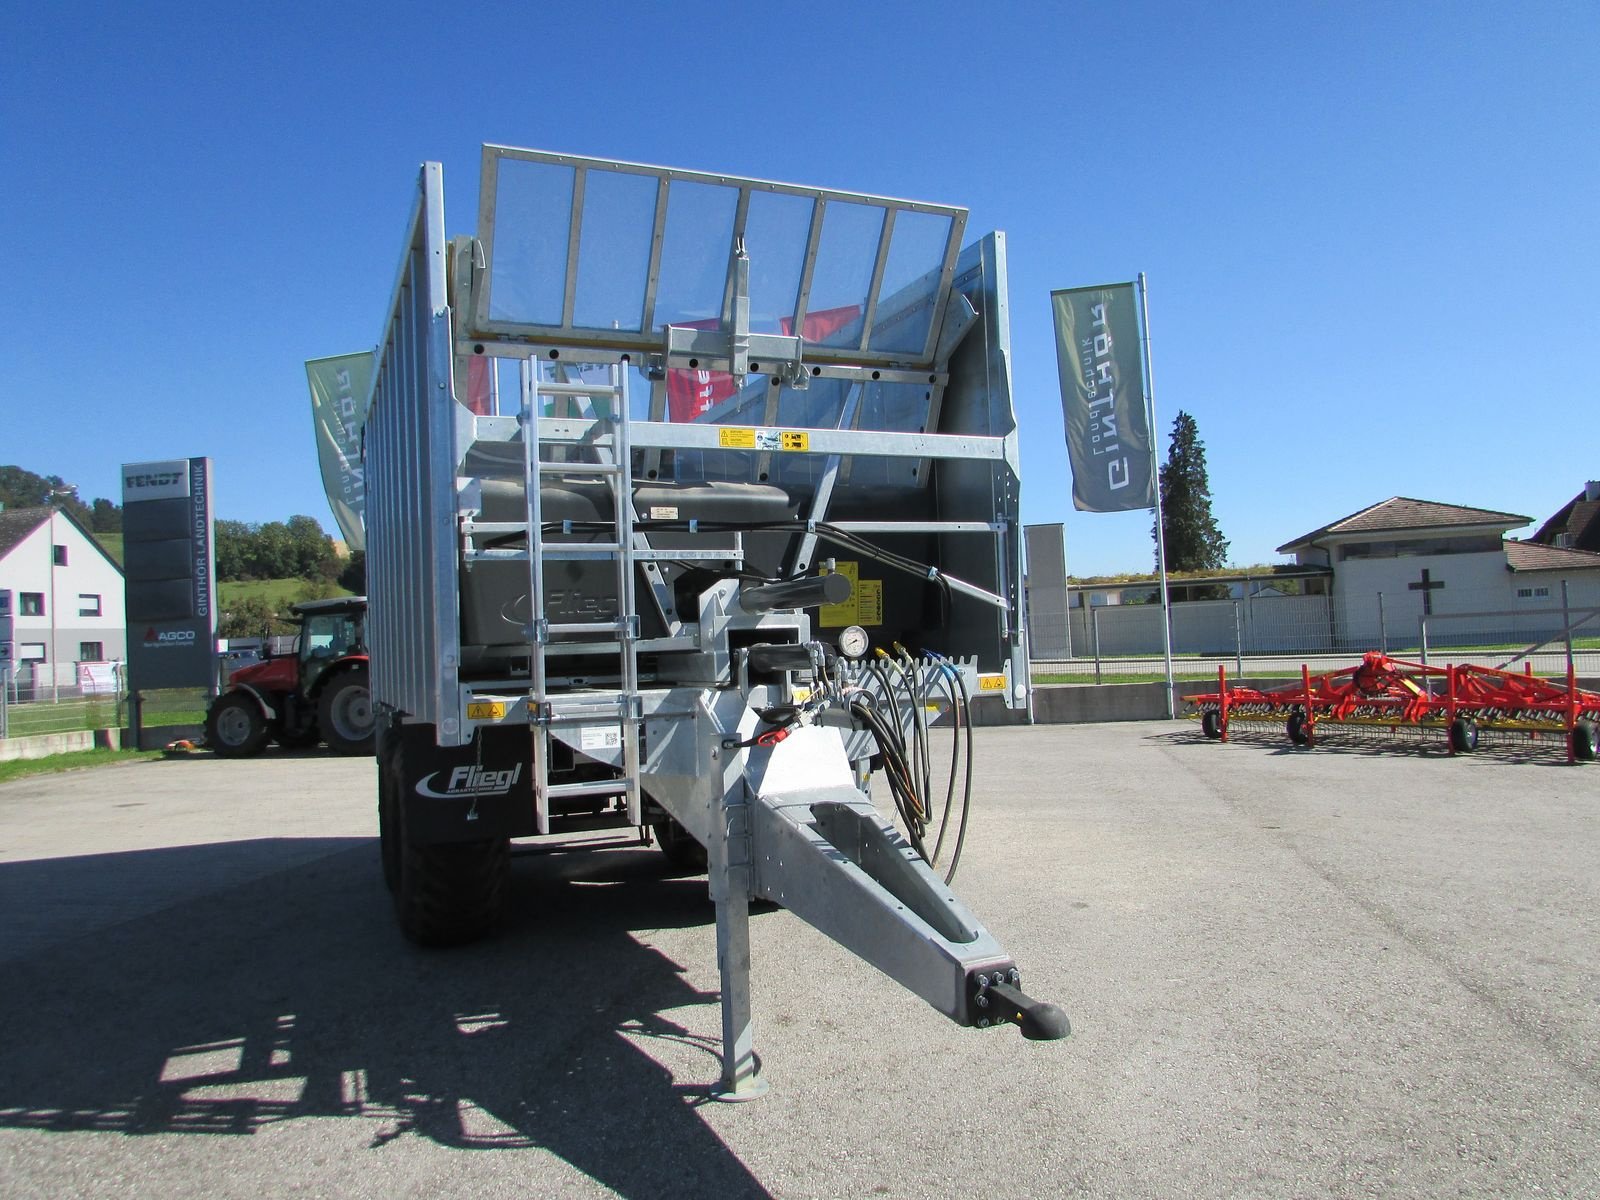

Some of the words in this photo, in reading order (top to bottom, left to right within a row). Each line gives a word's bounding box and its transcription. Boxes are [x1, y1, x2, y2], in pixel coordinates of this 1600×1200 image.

[125, 471, 184, 489] FENDT
[193, 464, 206, 554] LANDTECHNIK
[158, 630, 195, 641] AGCO
[448, 762, 523, 791] Fliegl
